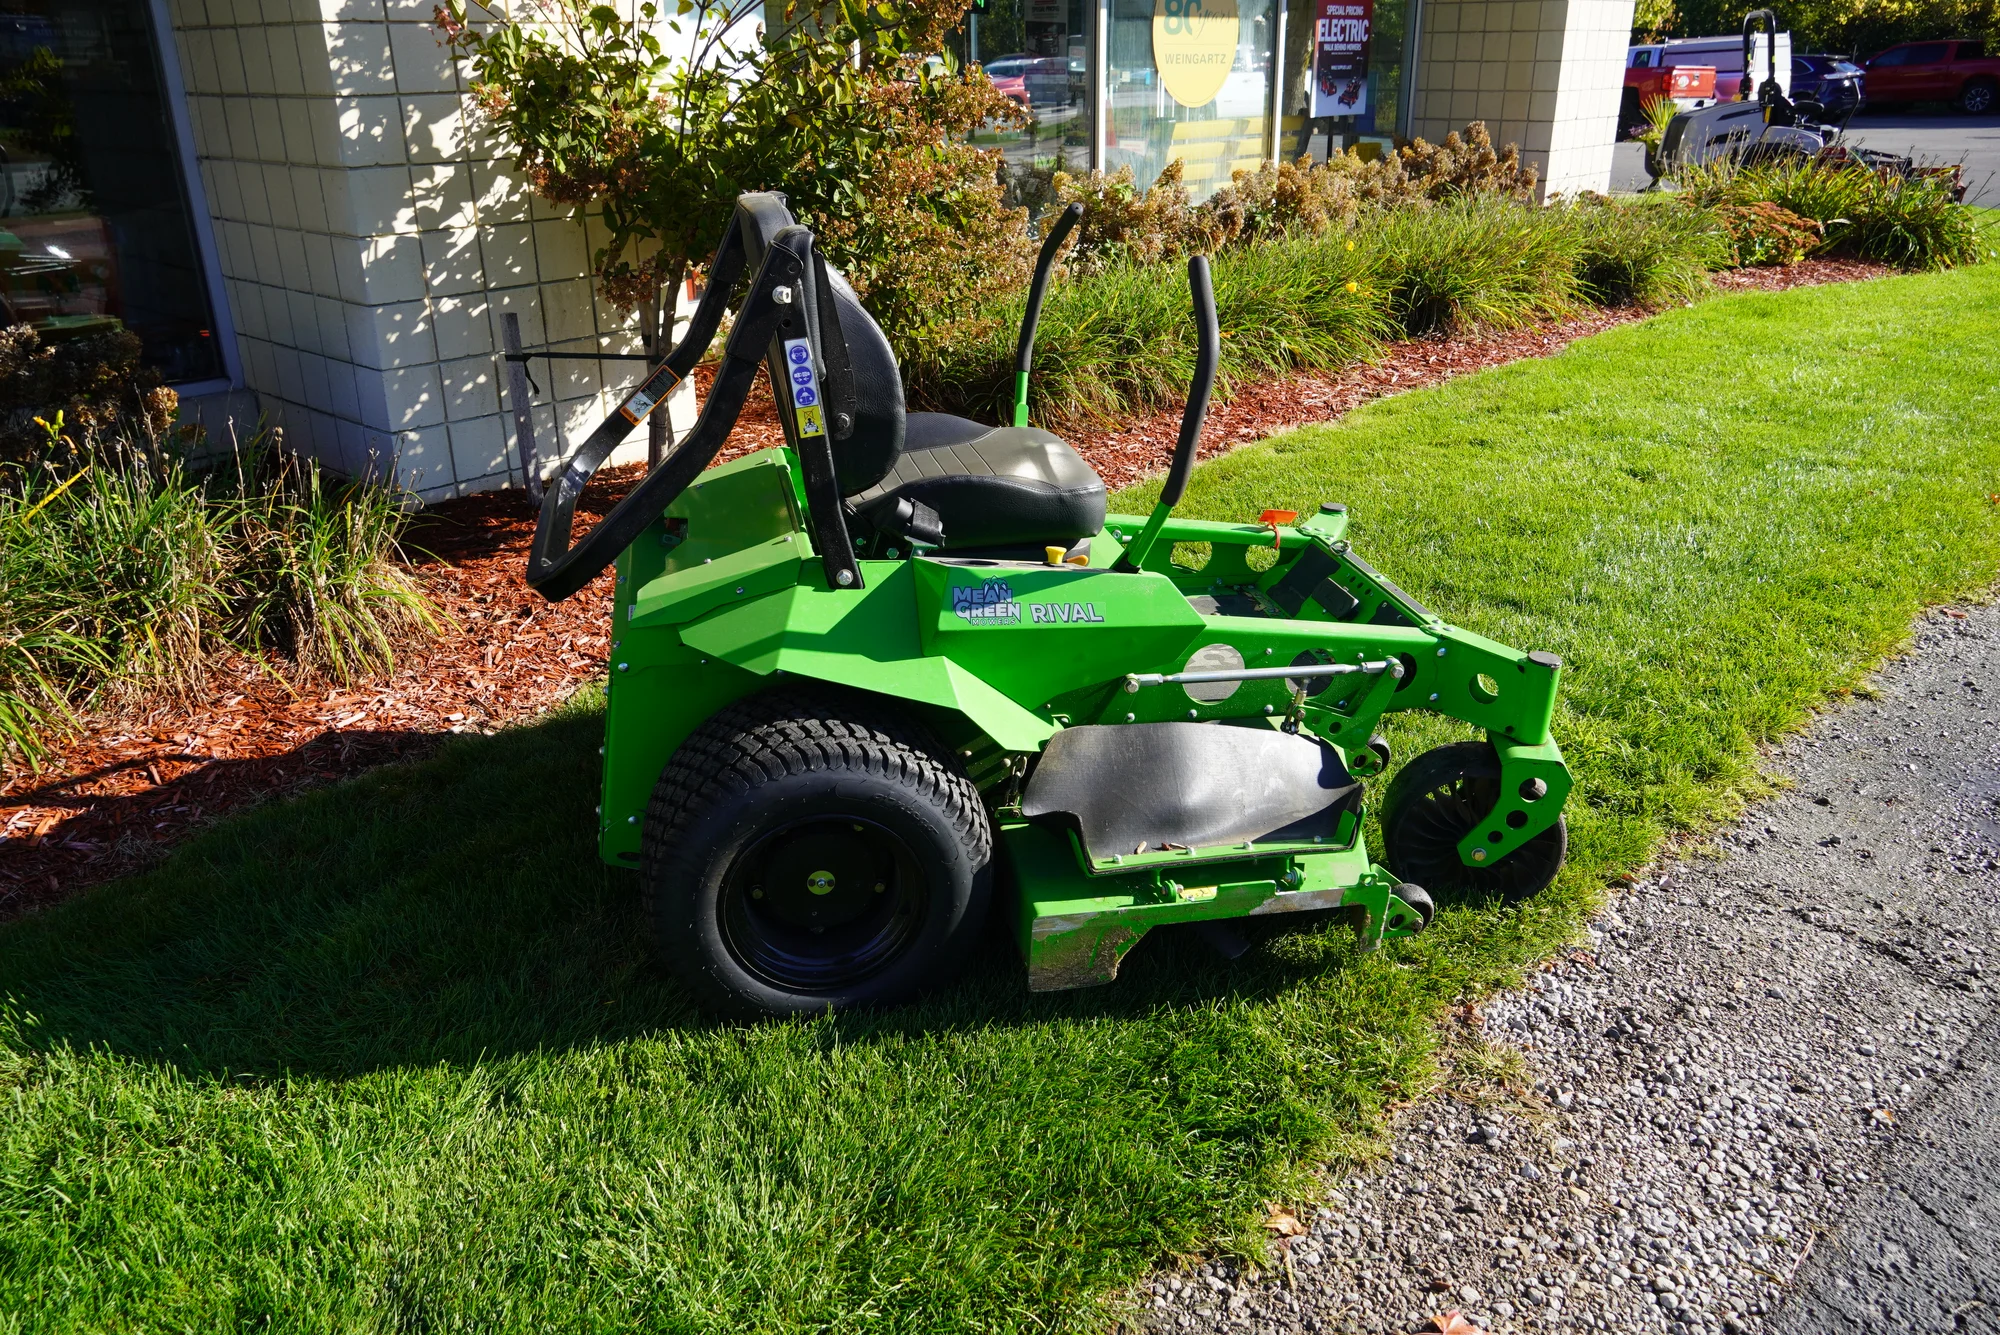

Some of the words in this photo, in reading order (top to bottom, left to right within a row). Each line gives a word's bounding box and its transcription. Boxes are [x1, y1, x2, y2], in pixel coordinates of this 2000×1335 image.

[1326, 5, 1345, 16] SPECIAL
[1345, 5, 1364, 16] PRICING
[1318, 18, 1369, 42] ELECTRIC
[1165, 53, 1227, 65] WEINGARTZ
[953, 586, 1013, 603] MEAN
[954, 601, 1021, 623] GREEN
[1029, 602, 1105, 624] RIVAL
[972, 617, 1017, 627] MOWERS
